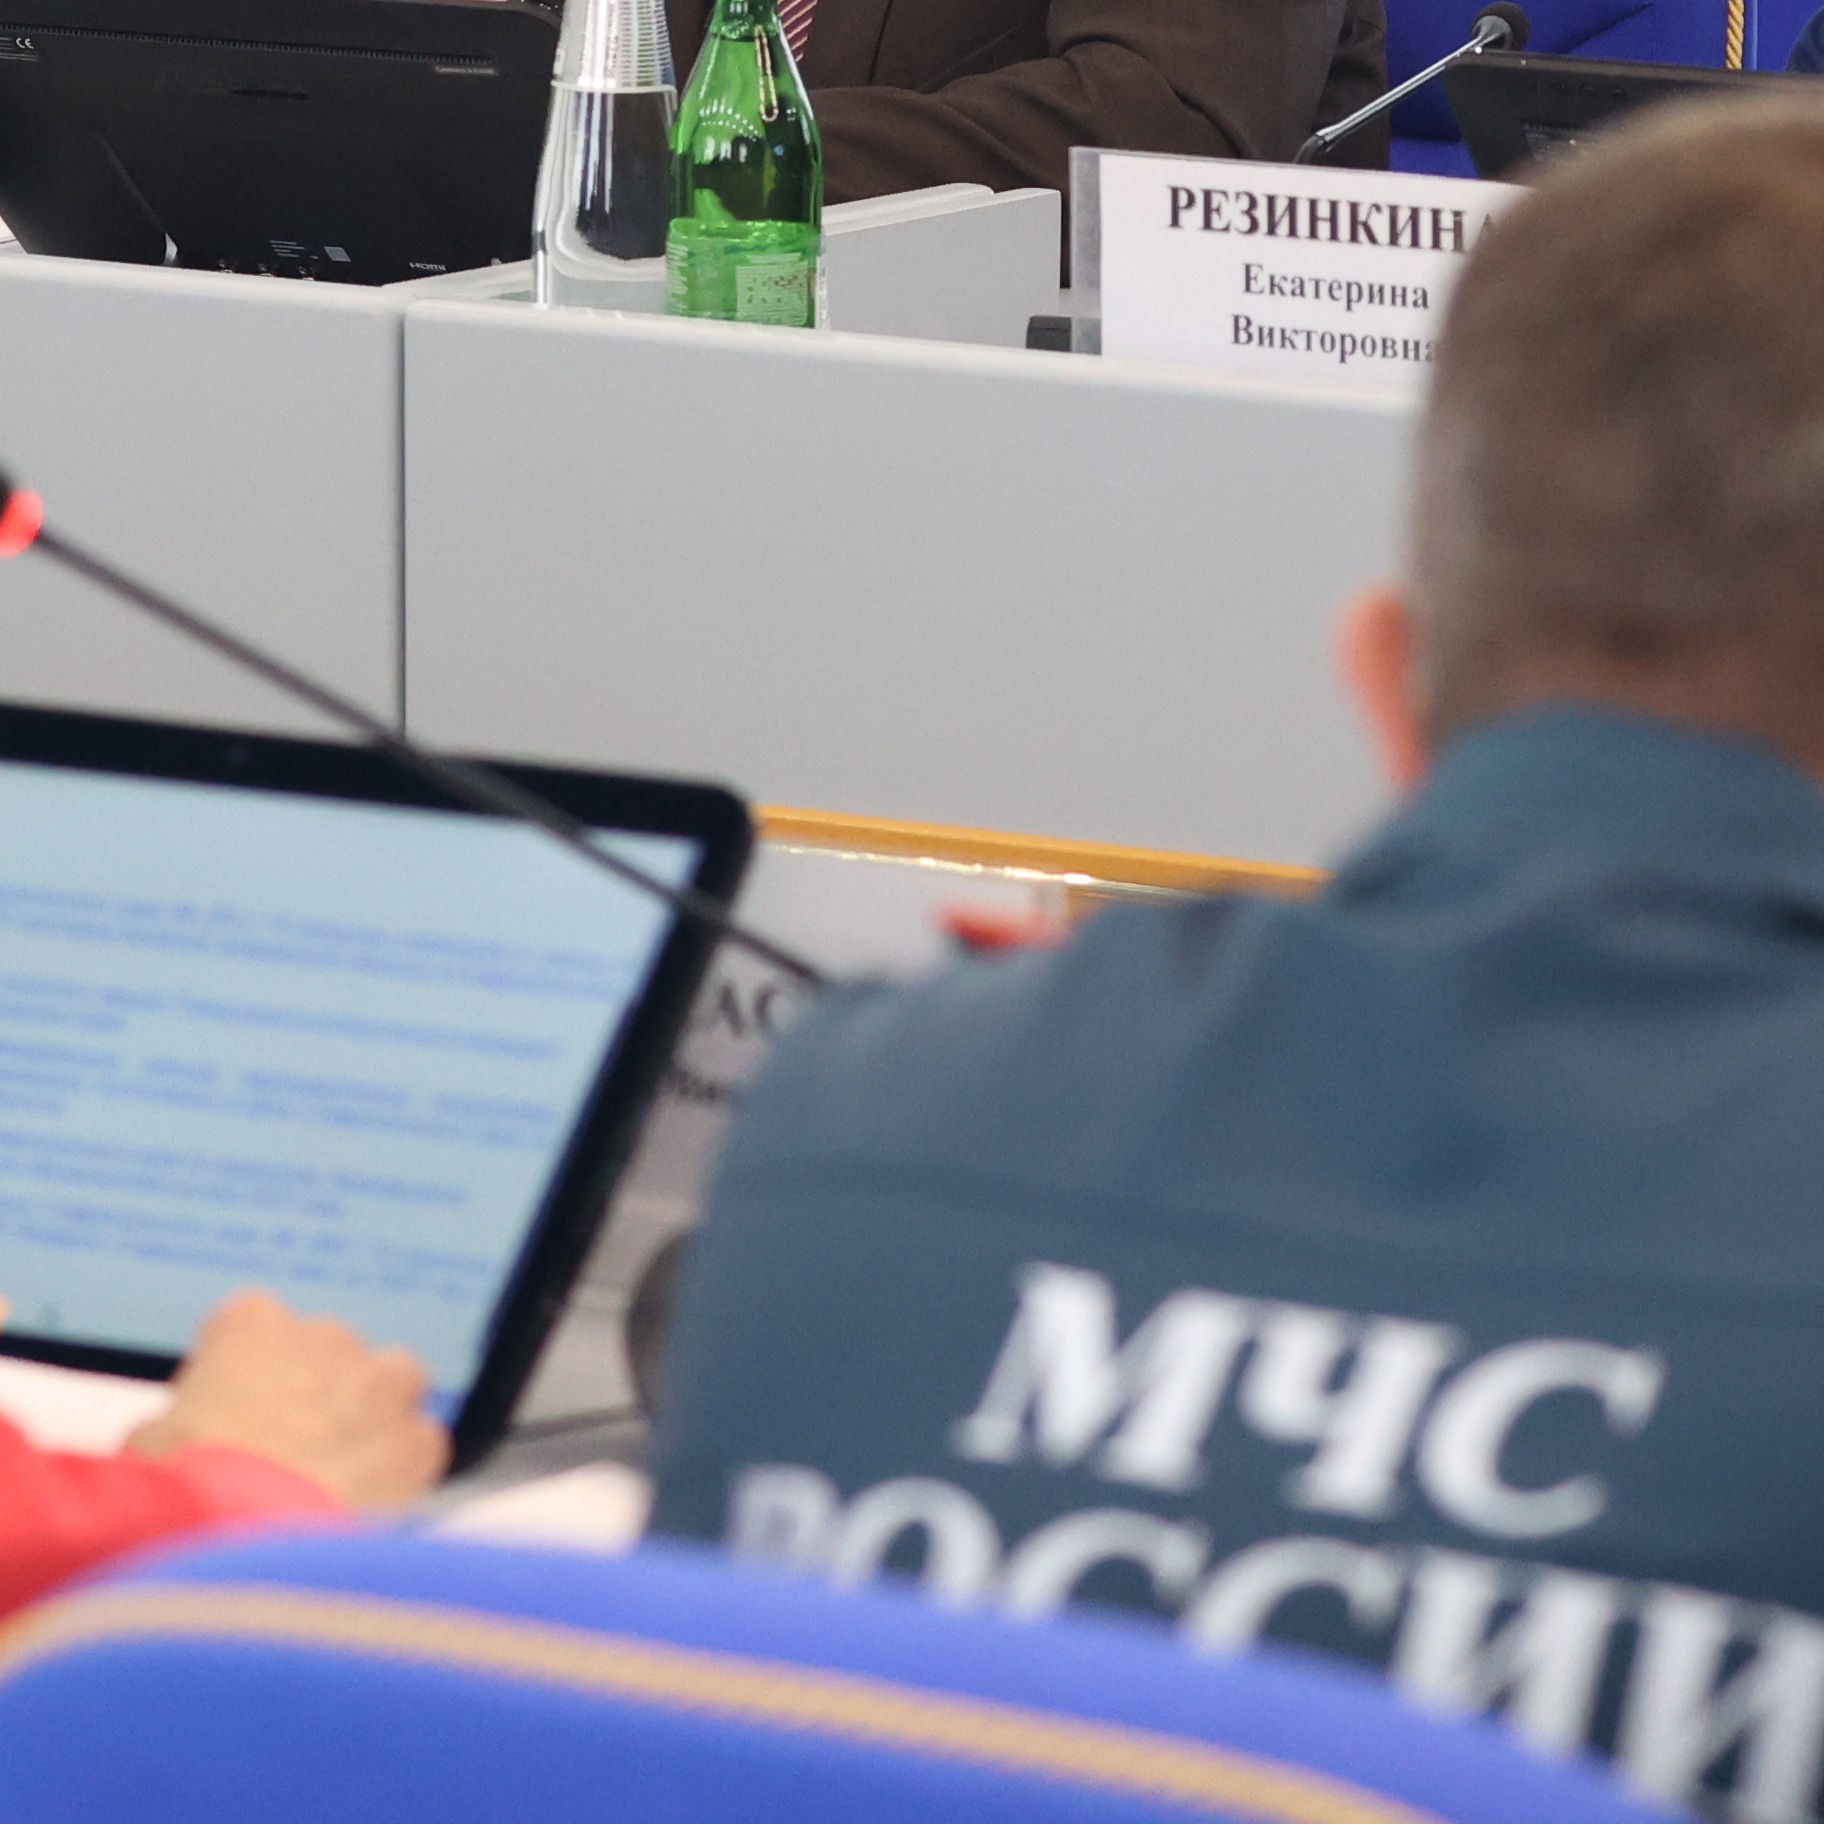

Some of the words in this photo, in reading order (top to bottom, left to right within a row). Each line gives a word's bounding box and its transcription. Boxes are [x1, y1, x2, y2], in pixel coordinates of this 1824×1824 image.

[1166, 185, 1495, 254] РЕЗИНКИН
[1241, 263, 1430, 312] Екатерина
[951, 1260, 1668, 1538] МЧС
